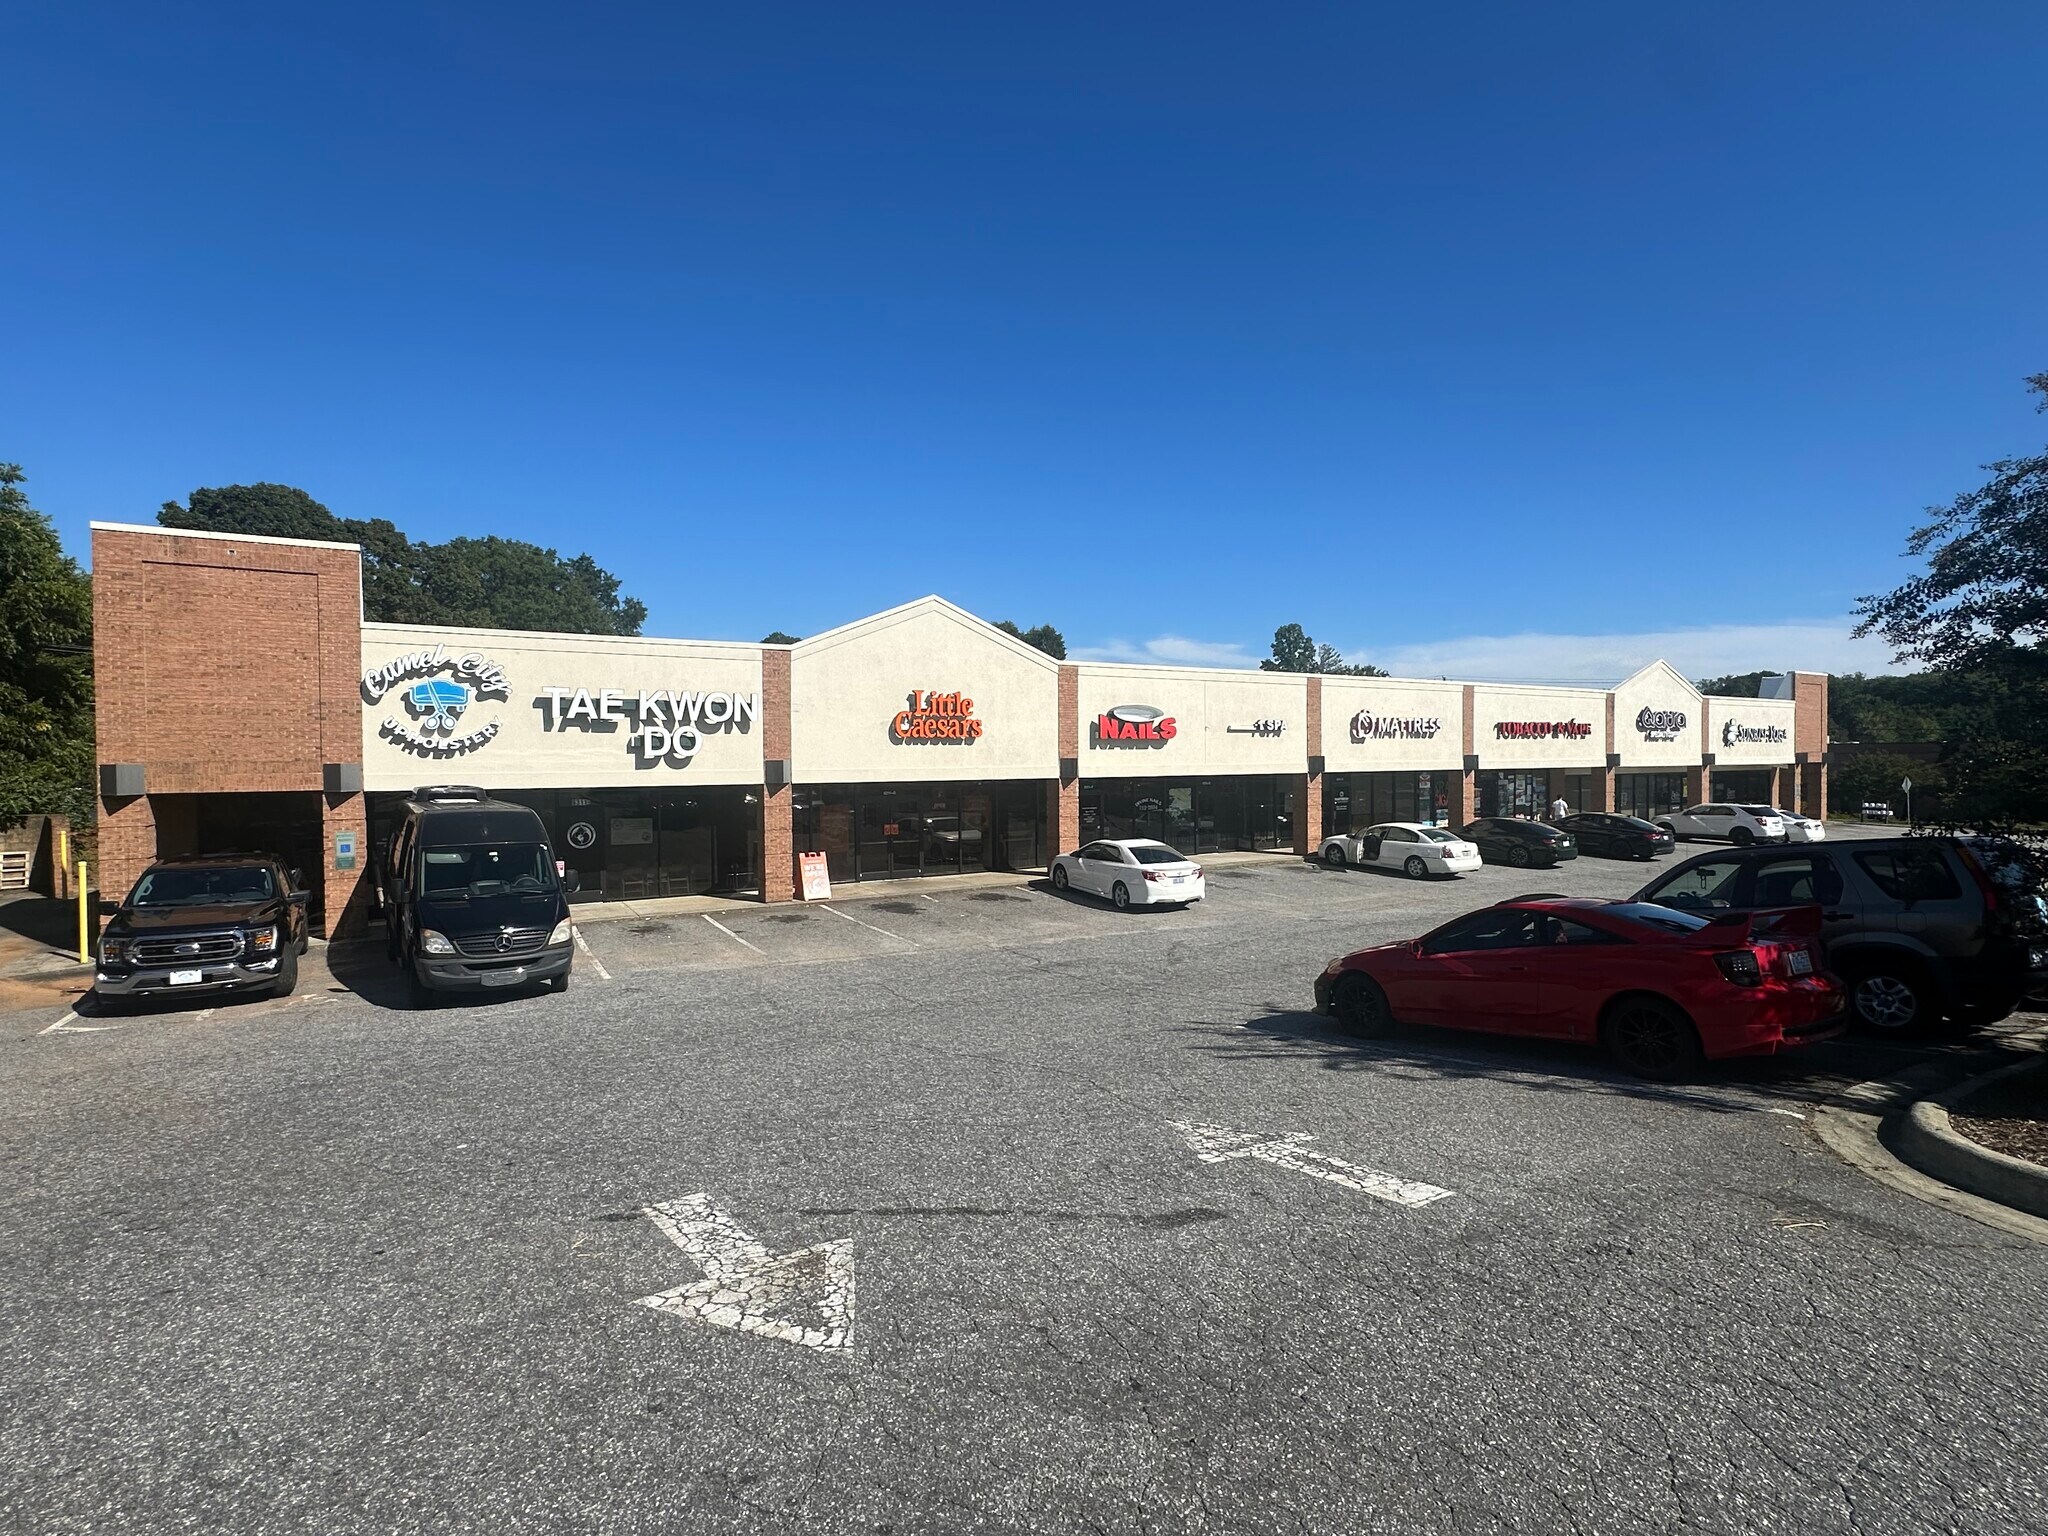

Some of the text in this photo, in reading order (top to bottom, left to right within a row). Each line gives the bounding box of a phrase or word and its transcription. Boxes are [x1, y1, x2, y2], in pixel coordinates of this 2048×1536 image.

[365, 643, 513, 698] Camel City
[542, 686, 759, 723] TAE KWON
[911, 689, 974, 717] Little
[385, 715, 504, 751] UPHOLSTERY
[895, 711, 983, 739] Caesars
[1098, 713, 1178, 740] NAILS
[1266, 719, 1288, 731] SPA
[1378, 717, 1443, 733] MATTRESS
[1499, 722, 1553, 735] TOBACCO
[1566, 721, 1592, 736] VAPE
[643, 725, 704, 759] DO
